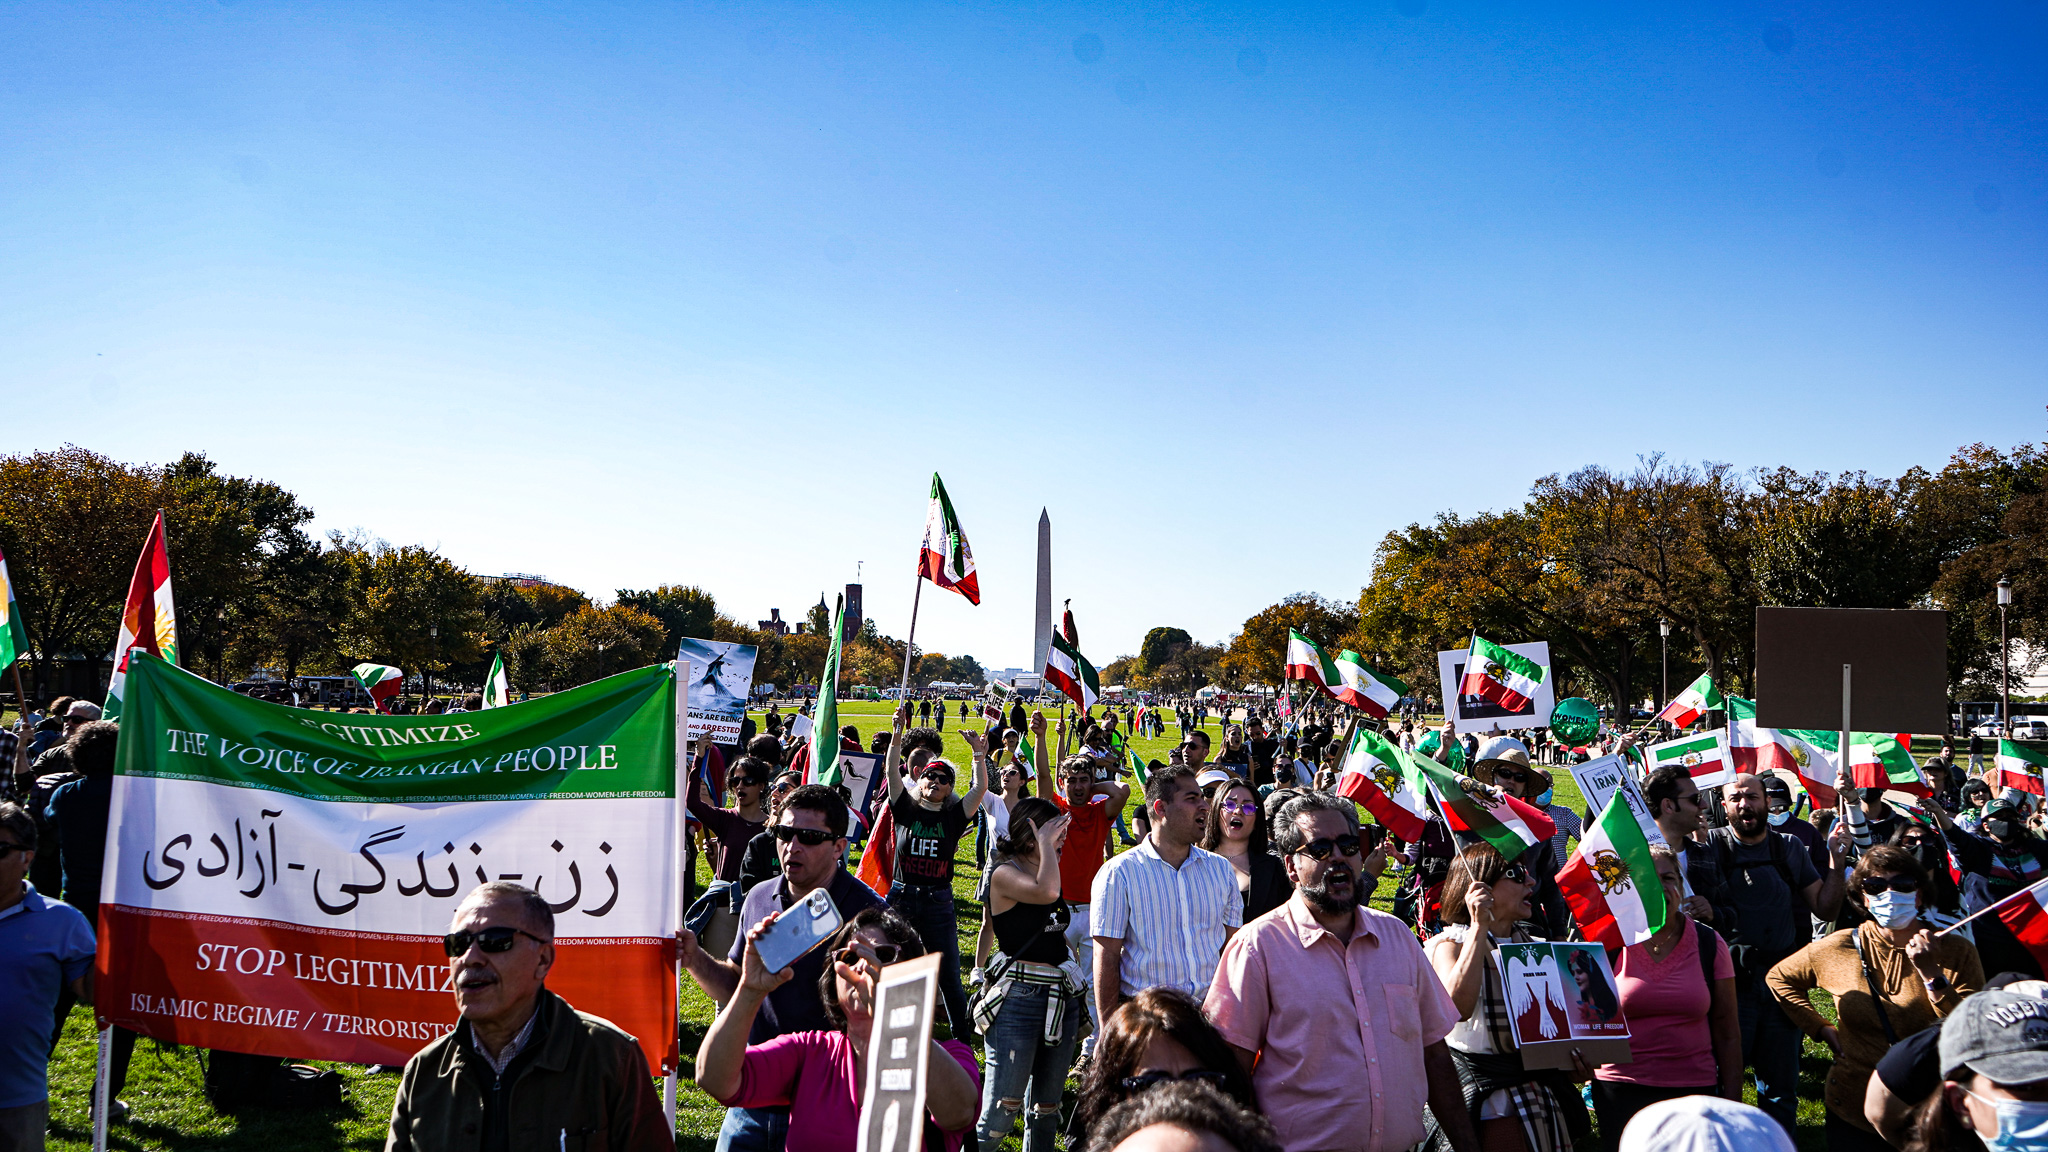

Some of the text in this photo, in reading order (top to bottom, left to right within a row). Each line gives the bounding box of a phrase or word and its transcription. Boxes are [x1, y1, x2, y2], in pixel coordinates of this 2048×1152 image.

[687, 711, 703, 719] ANS
[704, 713, 719, 721] ARE
[720, 715, 742, 723] BEING
[1554, 713, 1588, 725] WOMEN
[286, 714, 480, 746] EGITIMIZE
[701, 723, 740, 733] ARRESTED
[716, 735, 737, 743] TODAY
[167, 729, 618, 778] THE VOICE OF IRANIAN PEOPLE
[1592, 774, 1619, 790] IRAN
[911, 821, 945, 838] WOMEN
[911, 838, 938, 857] LIFE
[900, 855, 948, 878] FREEDOM
[196, 943, 456, 993] STOP LEGITIMIZ
[131, 993, 208, 1020] ISLAMIC
[213, 1003, 300, 1029] REGIME
[1604, 1022, 1624, 1030] FREEDOM
